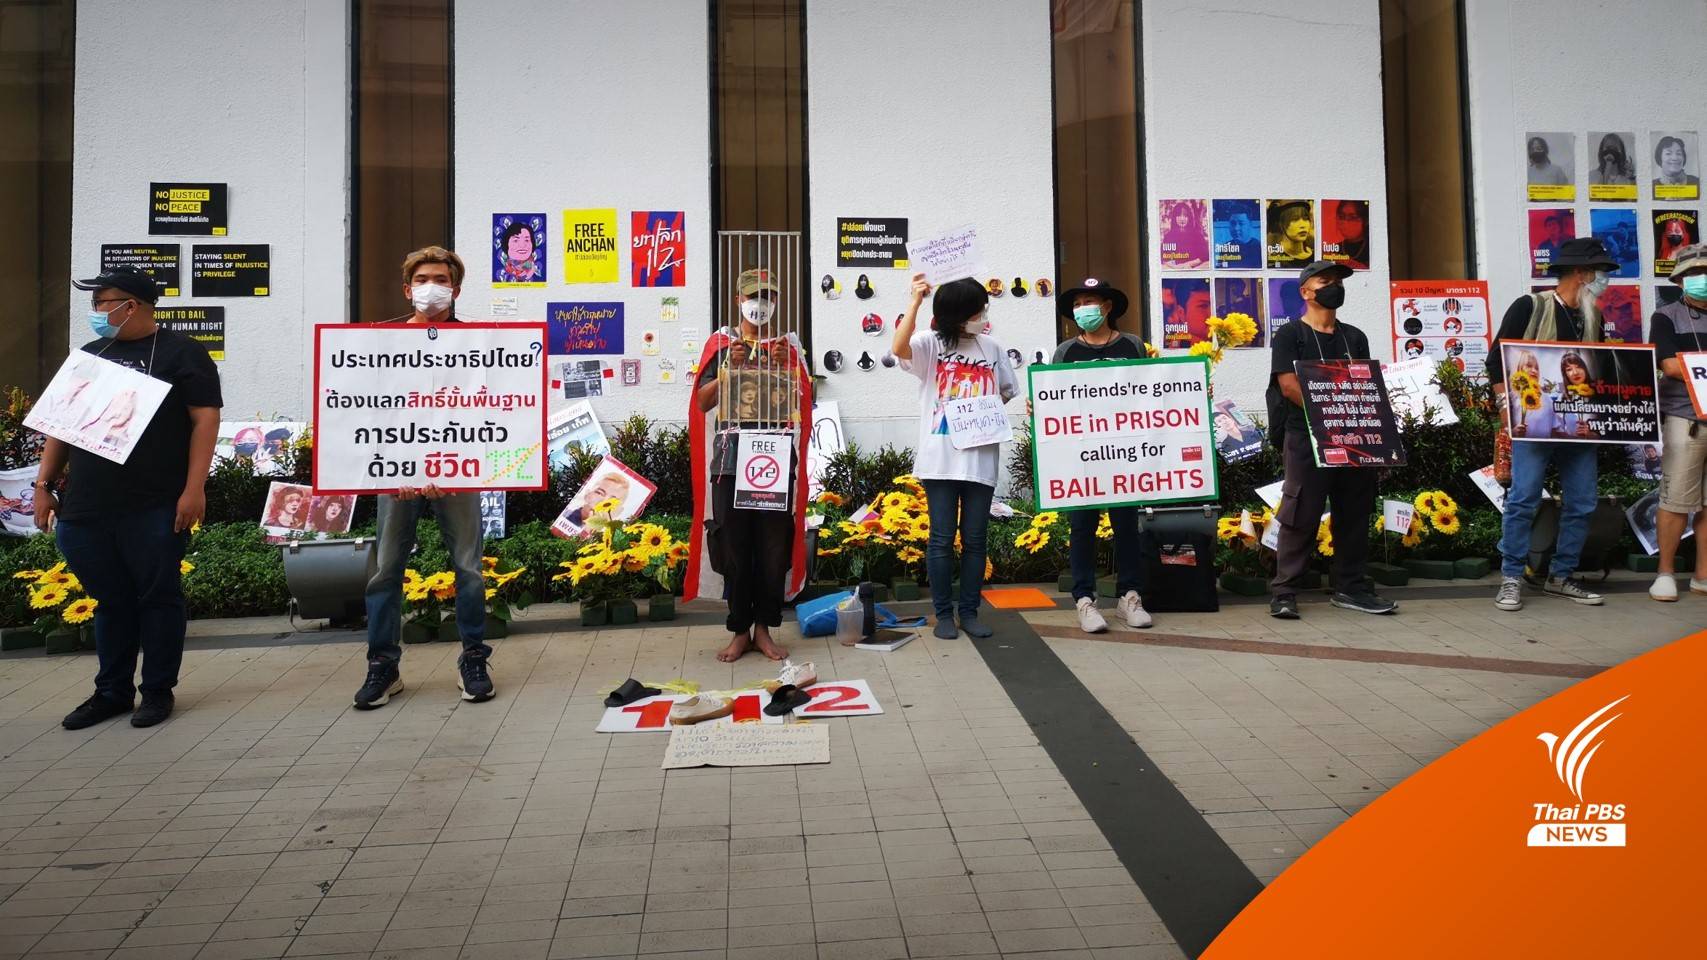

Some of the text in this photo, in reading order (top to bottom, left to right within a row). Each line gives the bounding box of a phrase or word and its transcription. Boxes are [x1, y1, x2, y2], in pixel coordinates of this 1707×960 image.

[155, 191, 208, 199] NO JUSTICE
[155, 203, 200, 211] NO PEACE
[574, 223, 605, 238] FREE
[566, 237, 615, 253] ANCHAN
[177, 311, 186, 319] TO
[188, 311, 206, 319] BAIL
[171, 322, 198, 331] HUMAN
[200, 322, 223, 331] RIGHT
[326, 385, 536, 411] ต้องแลกสิทธิ์ขั้นพื้นฐาน
[1038, 381, 1202, 401] our friends're gonna
[1554, 398, 1656, 415] แต่เปลี่ยนบางอย่างได้
[1044, 407, 1200, 436] DIE in PRISON
[1587, 418, 1656, 436] หนูว่ามันคุ้ม"
[354, 420, 509, 444] การประกันตัว
[1364, 434, 1383, 445] 112
[751, 440, 777, 452] FREE
[1080, 442, 1166, 463] calling for
[367, 453, 417, 478] ด้วย
[424, 451, 480, 478] ชีวิต
[750, 466, 776, 479] 112
[1049, 469, 1204, 500] BAIL RIGHTS
[480, 497, 502, 508] AIL
